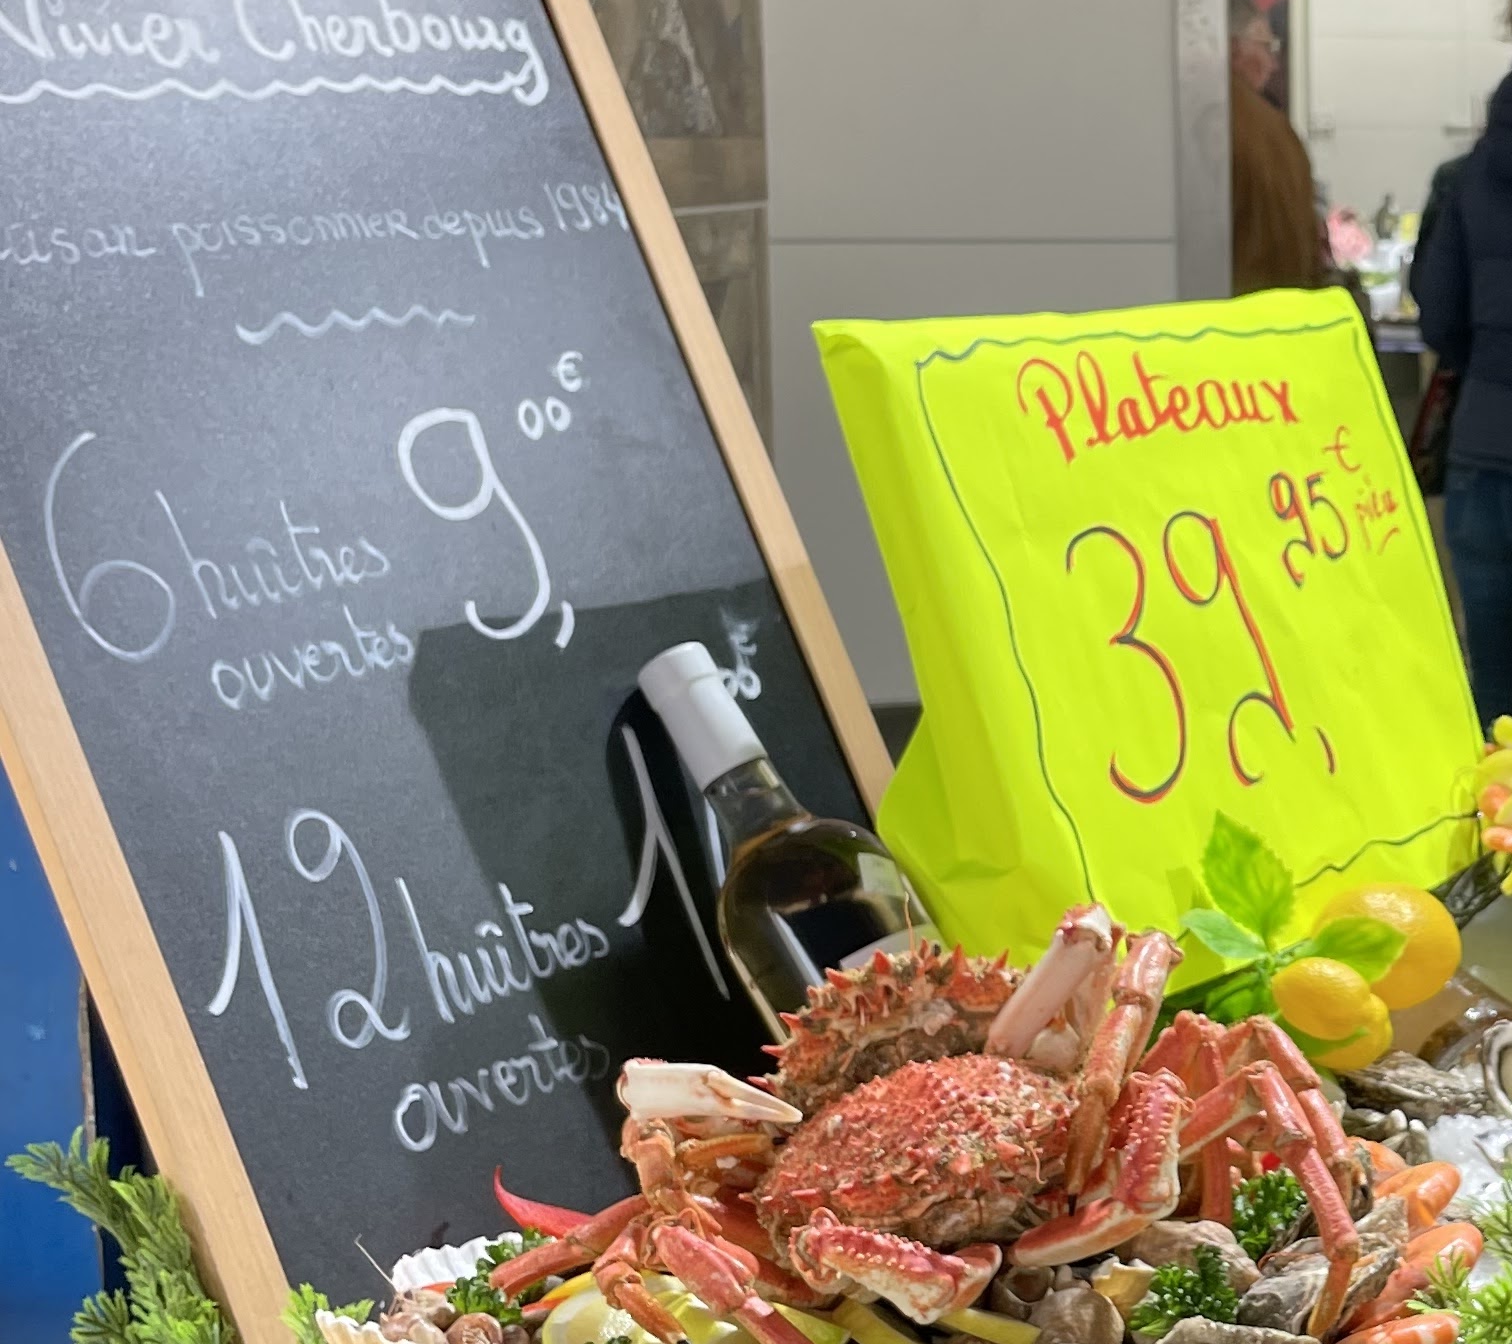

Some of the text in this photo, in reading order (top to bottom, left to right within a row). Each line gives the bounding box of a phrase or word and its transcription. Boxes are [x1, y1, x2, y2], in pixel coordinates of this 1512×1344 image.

[422, 193, 546, 269] depuis
[543, 181, 630, 233] 1984
[1016, 350, 1302, 465] Plateaux
[44, 431, 176, 657] 6
[211, 605, 415, 709] ouvertes
[207, 807, 410, 1090] 12
[396, 877, 610, 1024] huîtres
[392, 1013, 612, 1153] ouvertes
